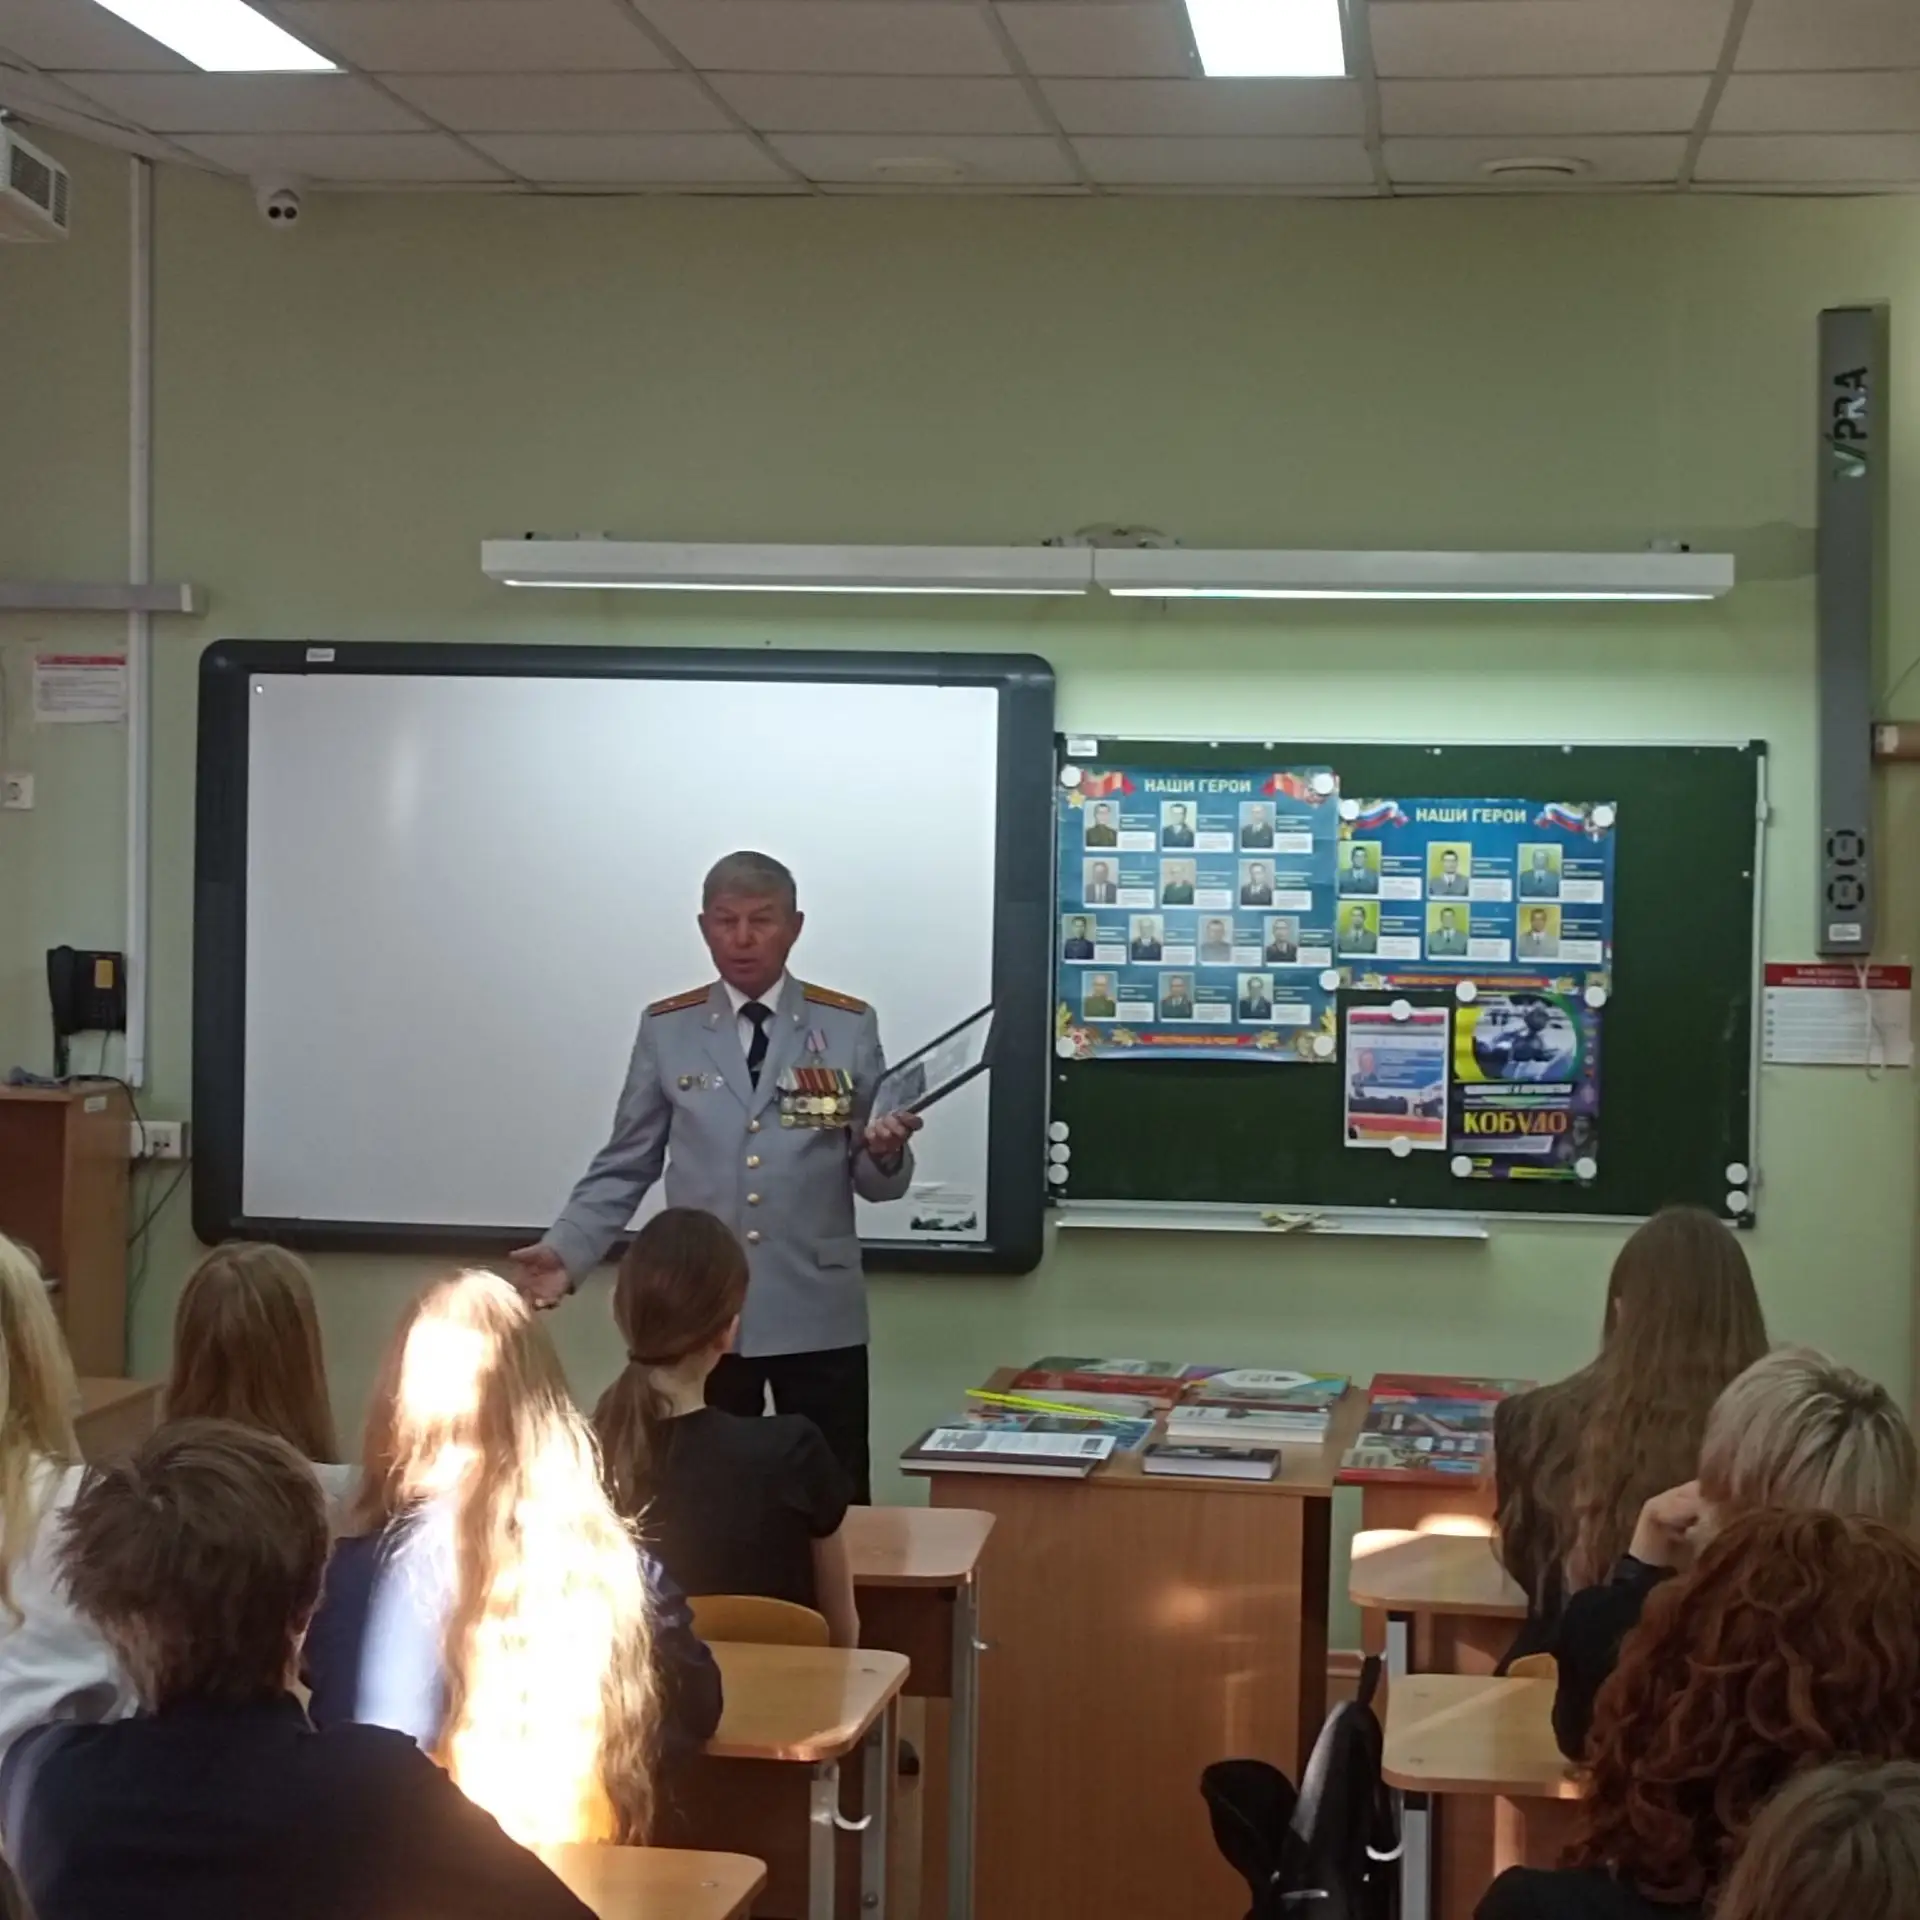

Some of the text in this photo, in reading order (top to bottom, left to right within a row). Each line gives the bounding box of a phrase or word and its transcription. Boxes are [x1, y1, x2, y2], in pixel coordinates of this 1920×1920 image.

[1144, 779, 1252, 793] НАШИ ГЕРОИ
[1415, 807, 1528, 824] НАШИ ГЕРОИ
